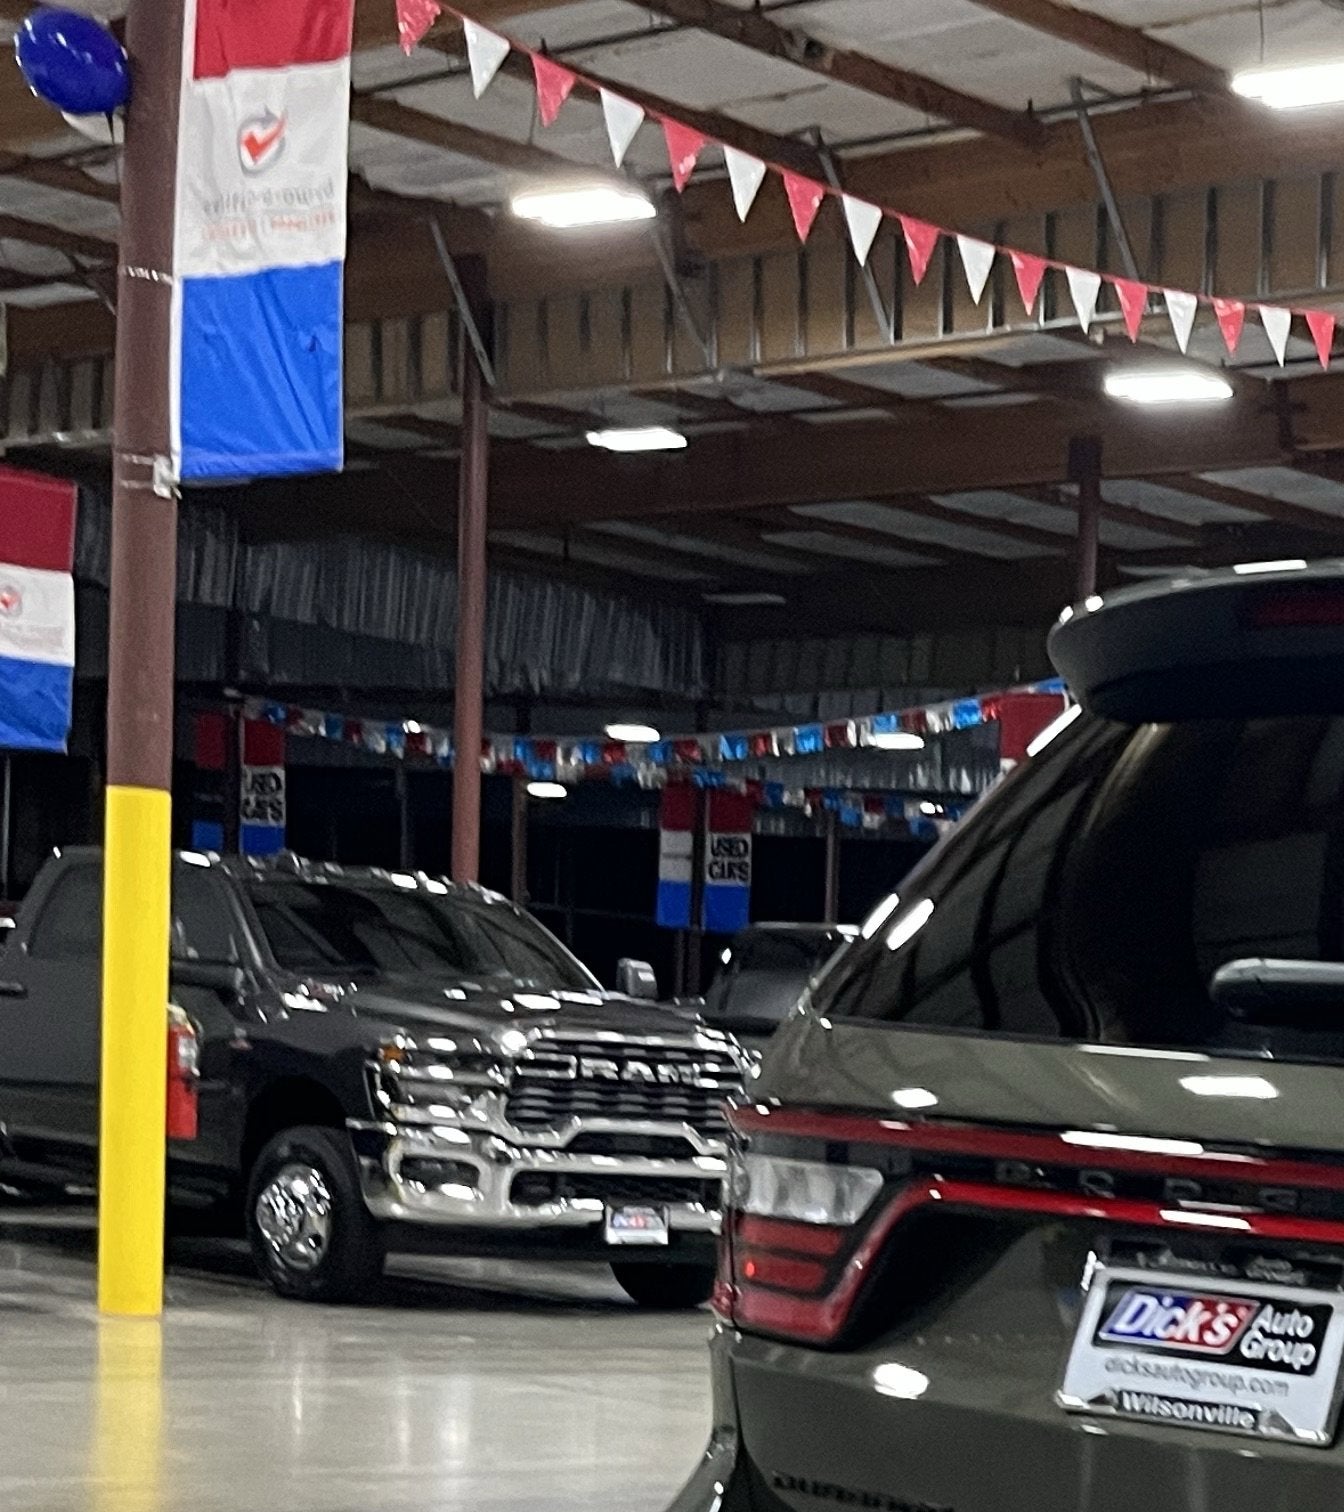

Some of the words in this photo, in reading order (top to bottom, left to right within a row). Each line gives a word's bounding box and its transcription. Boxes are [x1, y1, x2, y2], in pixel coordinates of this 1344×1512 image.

[580, 1057, 700, 1087] RAM
[1251, 1304, 1315, 1339] Auto
[1239, 1330, 1317, 1371] Group
[1104, 1355, 1290, 1397] dicksautogroup.com
[1121, 1390, 1257, 1429] Wilsonville
